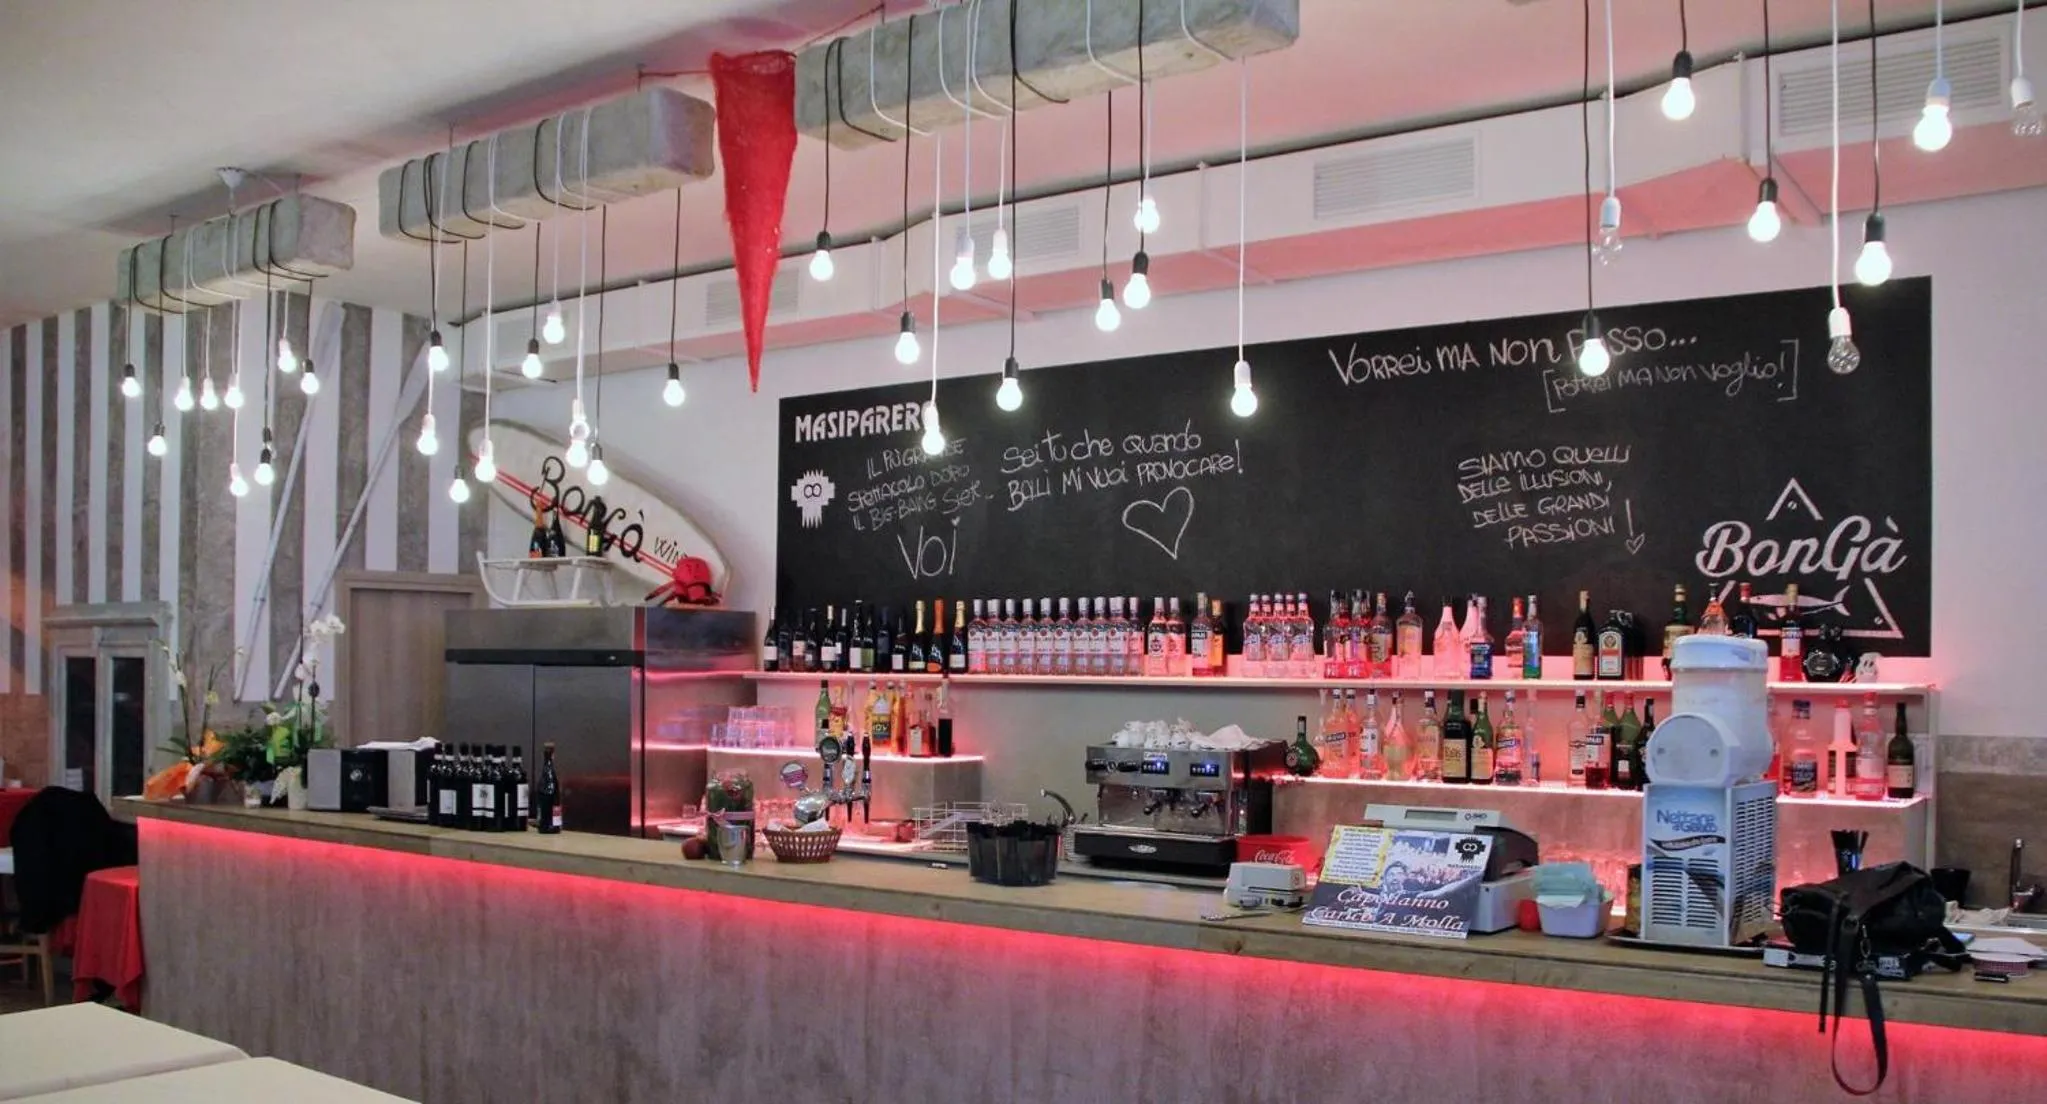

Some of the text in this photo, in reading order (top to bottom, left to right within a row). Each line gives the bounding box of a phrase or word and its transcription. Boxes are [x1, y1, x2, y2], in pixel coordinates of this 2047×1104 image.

[1070, 428, 1114, 460] che
[1458, 448, 1546, 480] SIAMO
[1472, 501, 1529, 528] DELLE
